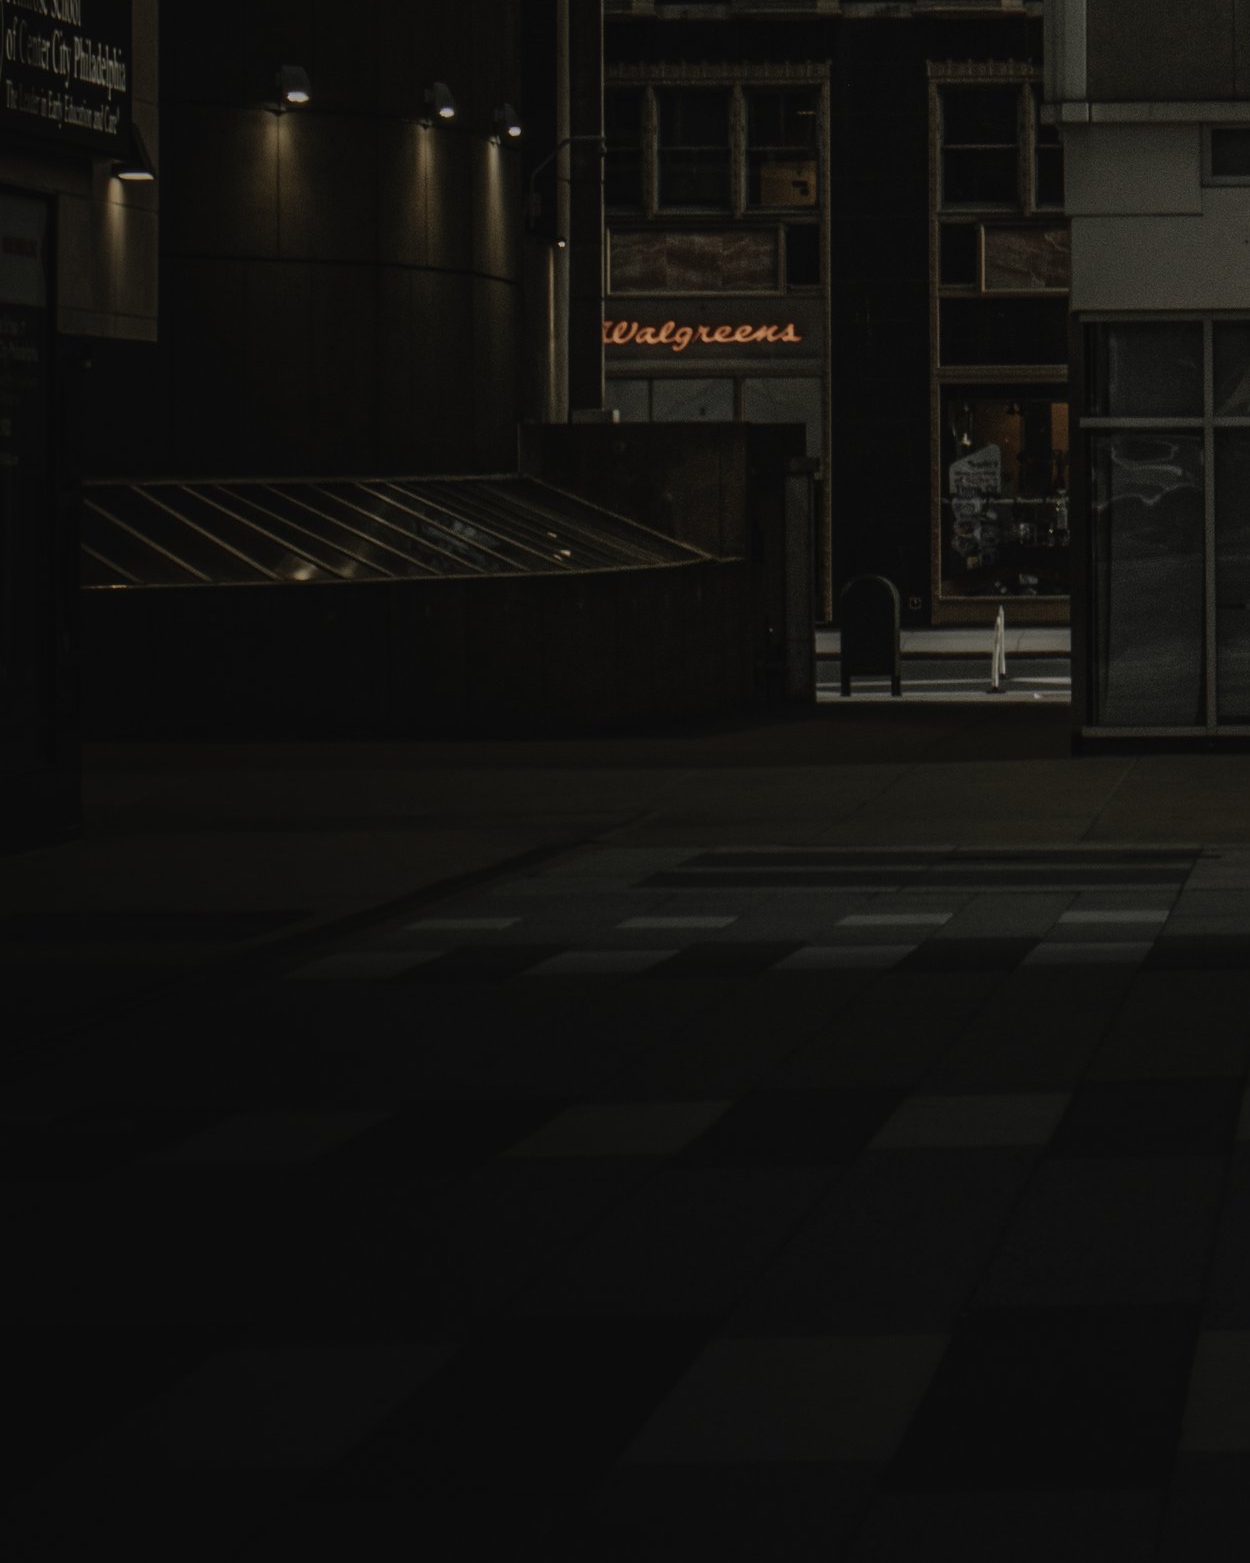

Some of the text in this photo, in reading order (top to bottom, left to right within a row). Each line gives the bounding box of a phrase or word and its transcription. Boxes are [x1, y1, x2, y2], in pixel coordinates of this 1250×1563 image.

[6, 15, 127, 102] of Center City Philadelphia
[602, 320, 802, 352] Walgreens
